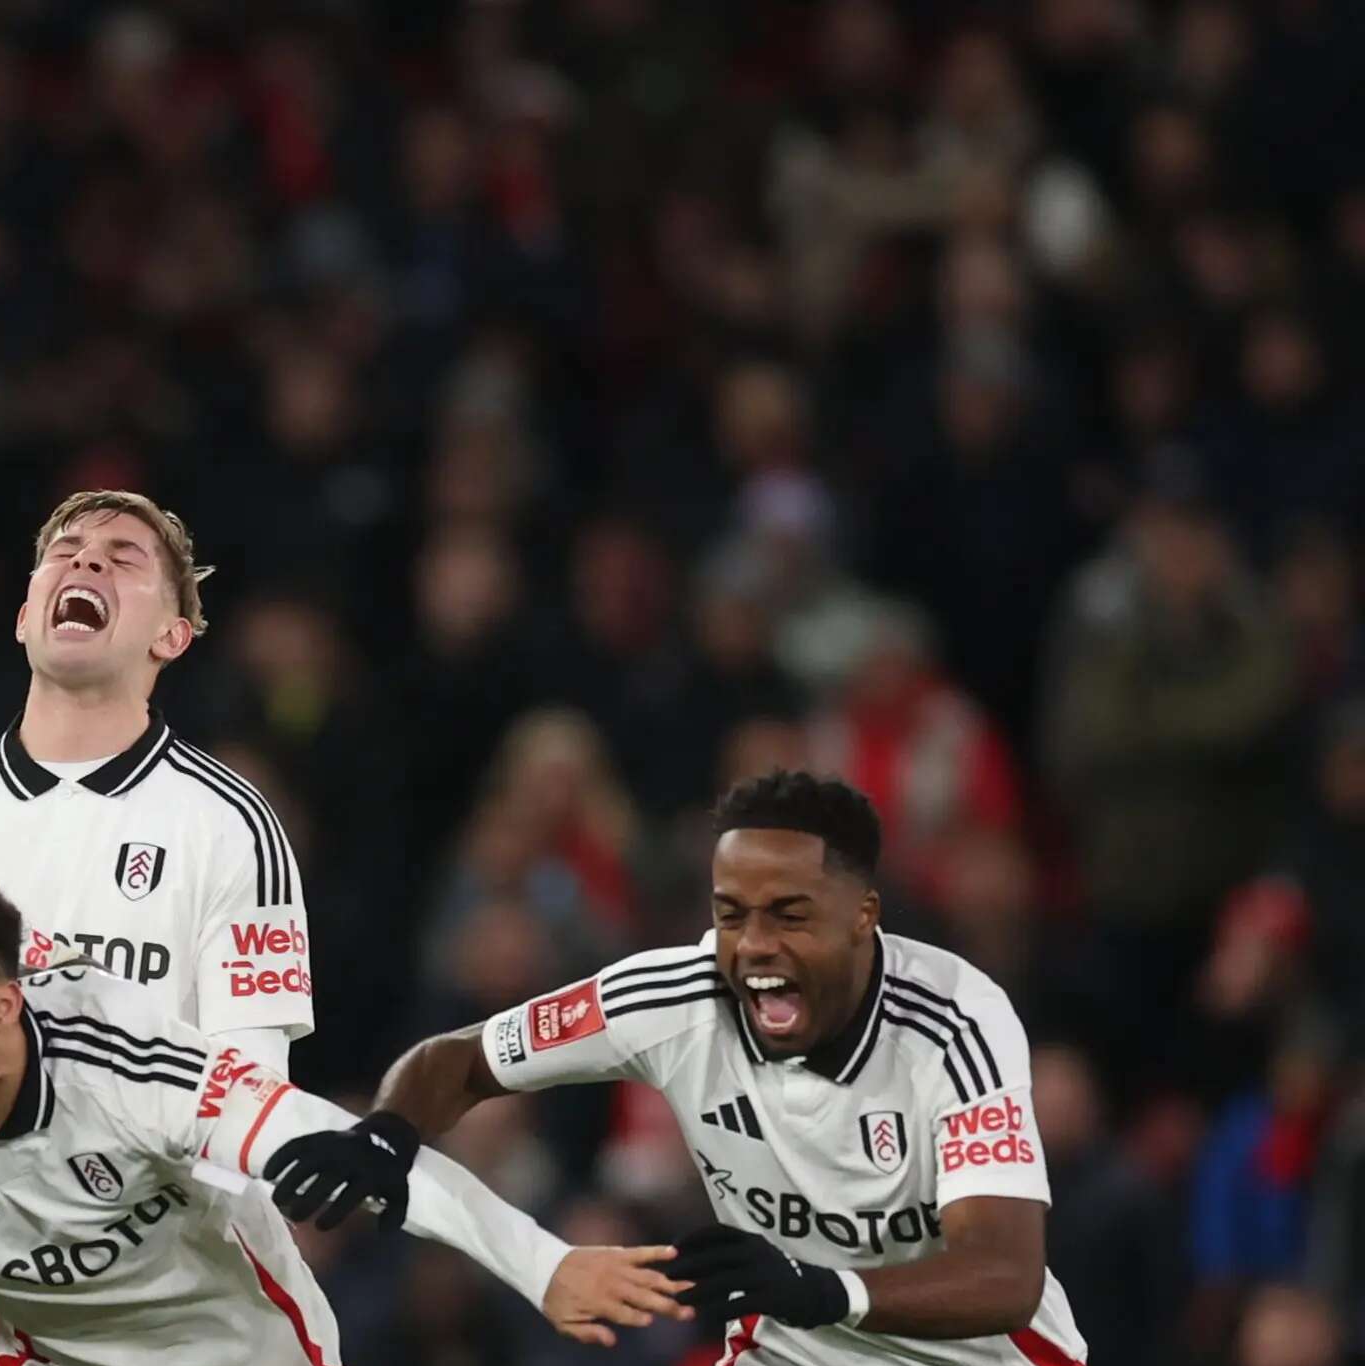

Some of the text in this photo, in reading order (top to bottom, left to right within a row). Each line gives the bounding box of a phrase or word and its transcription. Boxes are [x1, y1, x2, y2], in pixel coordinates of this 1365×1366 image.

[230, 919, 306, 956] Web
[221, 960, 313, 997] Beds
[943, 1096, 1025, 1138] Web
[939, 1134, 1035, 1173] Beds
